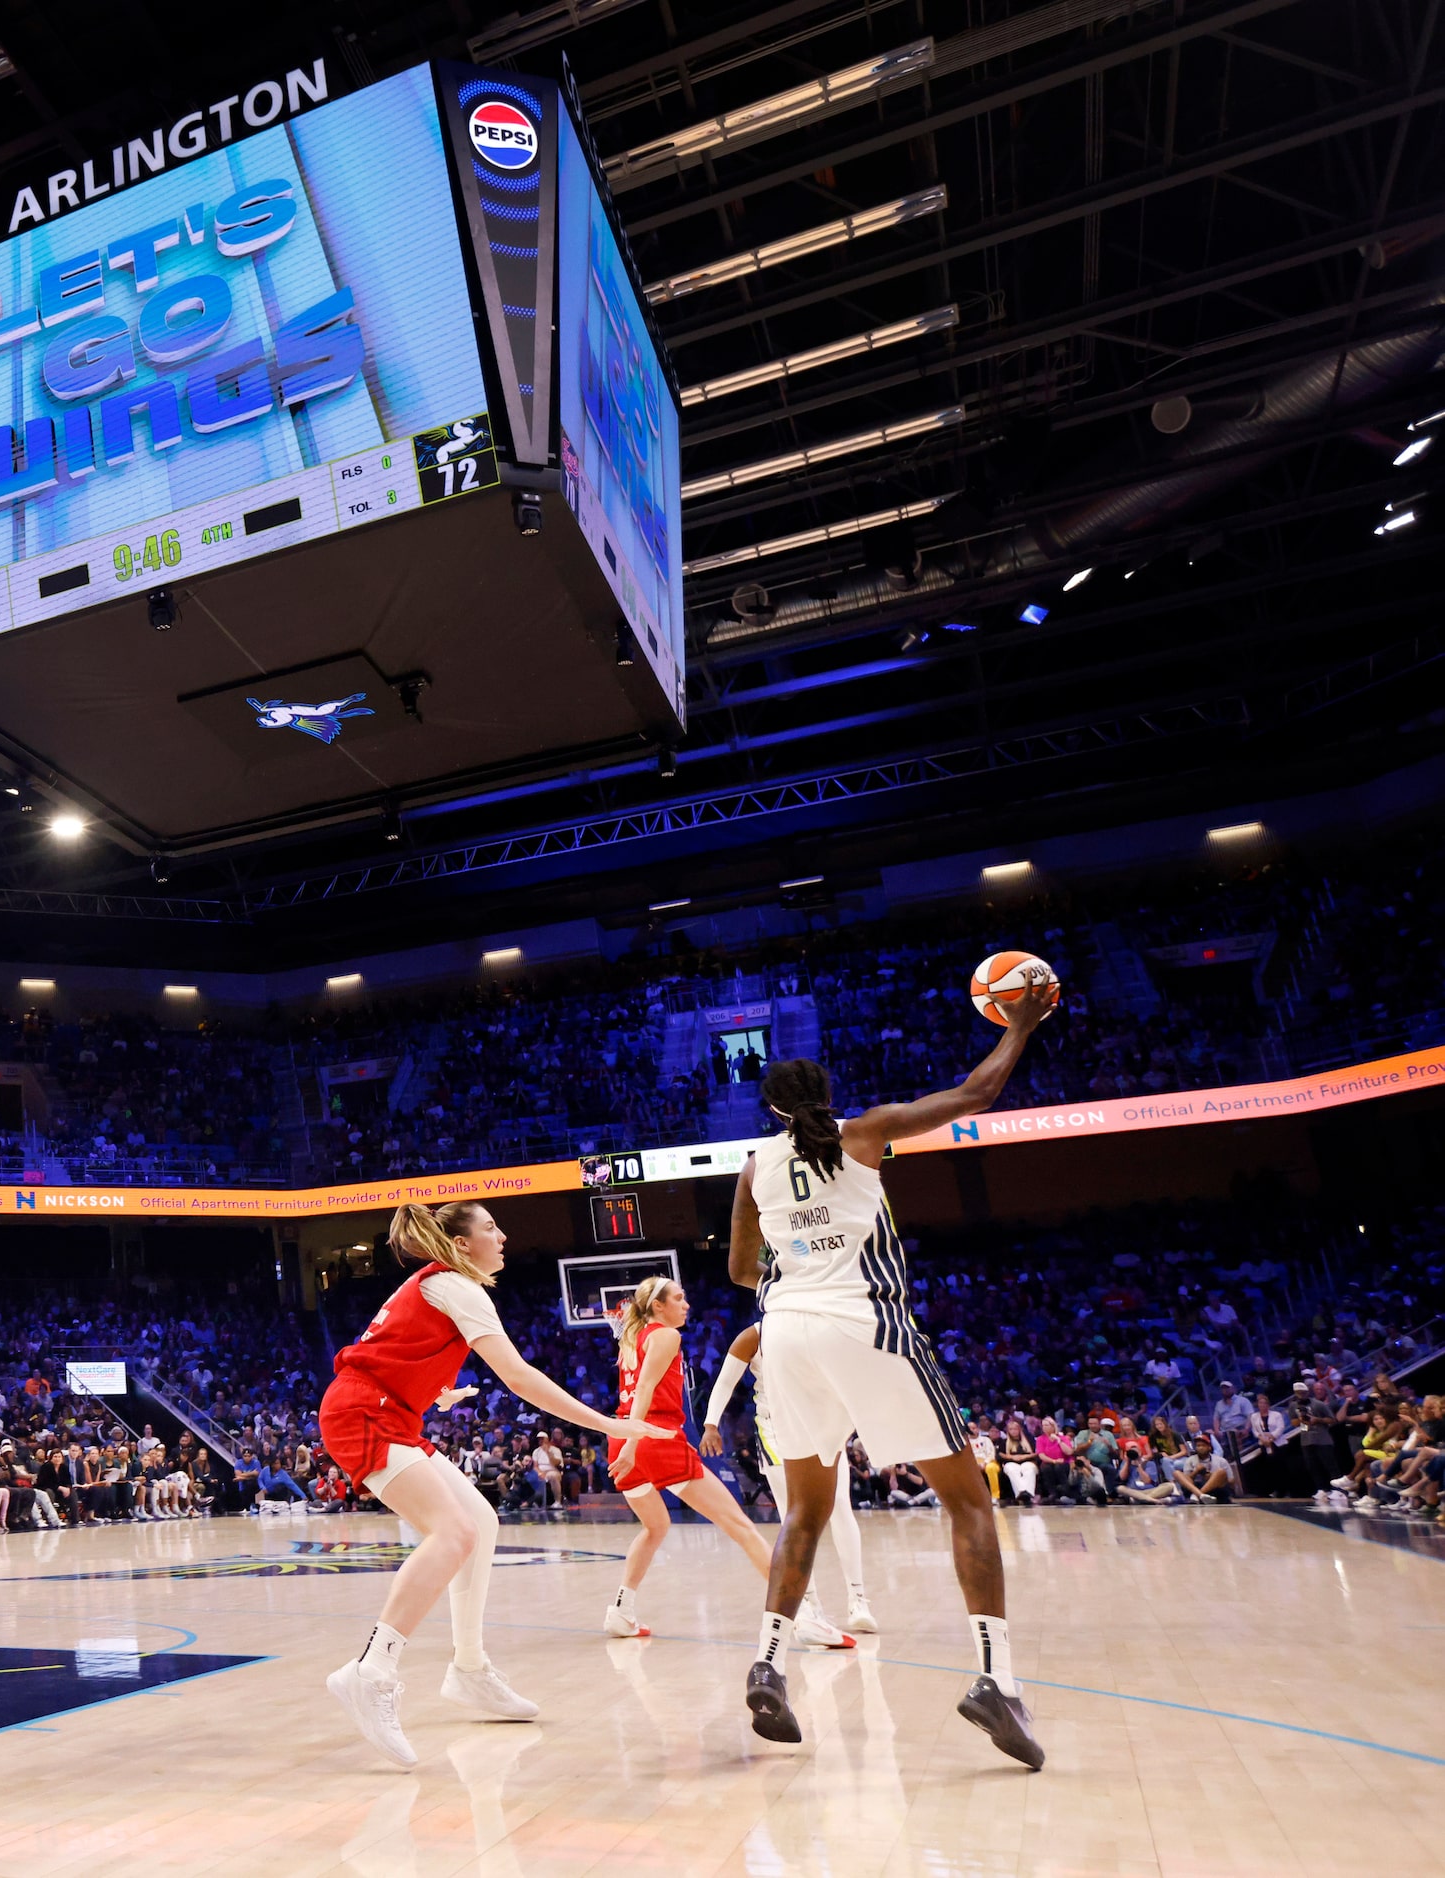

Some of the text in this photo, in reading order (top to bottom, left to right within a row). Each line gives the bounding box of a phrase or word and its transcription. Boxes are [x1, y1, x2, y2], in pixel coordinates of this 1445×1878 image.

[8, 57, 329, 233] ARLINGTON
[473, 124, 534, 146] PEPSI
[43, 275, 233, 401] GO
[341, 455, 392, 481] FLS 0
[437, 457, 480, 497] 72
[348, 489, 397, 516] TOL 3
[112, 521, 233, 582] 9:46 4TH
[991, 1109, 1106, 1137] NICKSON
[1123, 1102, 1194, 1122] Official
[1202, 1089, 1314, 1117] Apartment
[1319, 1071, 1400, 1097] Furniture
[614, 1158, 640, 1180] 70
[789, 1156, 811, 1203] 6
[44, 1194, 125, 1207] NICKSON
[140, 1197, 186, 1209] Official
[191, 1198, 260, 1213] Apartment
[264, 1197, 323, 1211] Furniture
[327, 1191, 384, 1207] Provider
[387, 1188, 402, 1201] of
[405, 1186, 433, 1200] The
[437, 1181, 479, 1197] Dallas
[483, 1175, 532, 1191] Wings
[788, 1206, 831, 1231] HOWARD
[810, 1234, 846, 1253] AT&T
